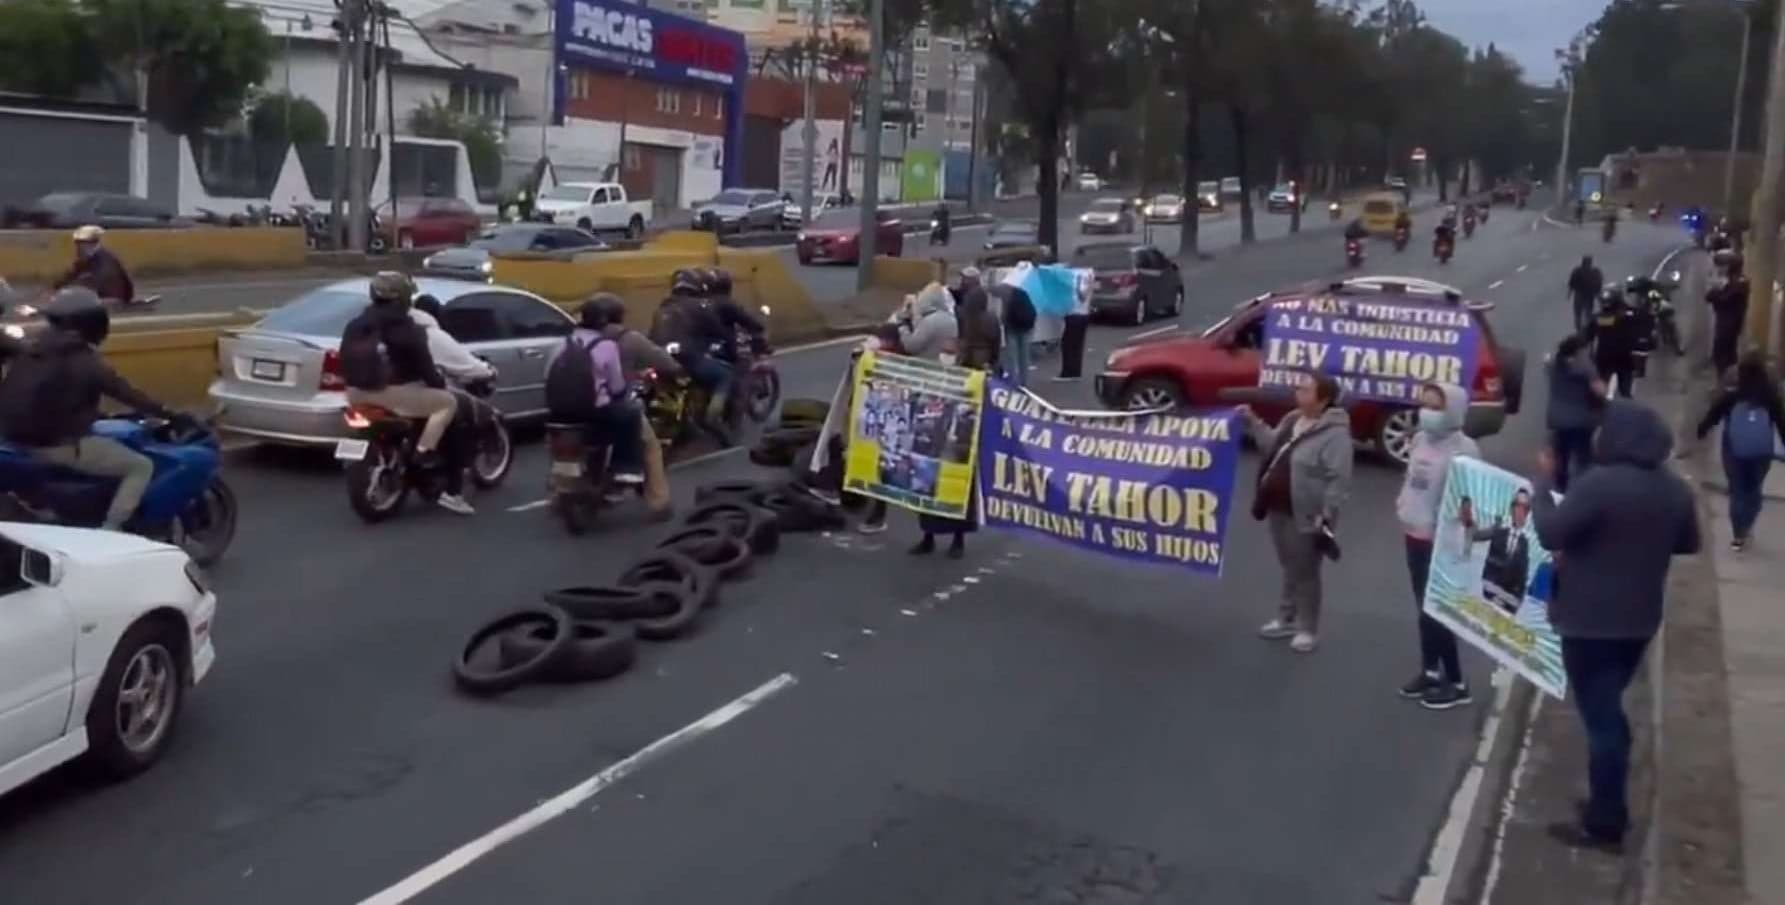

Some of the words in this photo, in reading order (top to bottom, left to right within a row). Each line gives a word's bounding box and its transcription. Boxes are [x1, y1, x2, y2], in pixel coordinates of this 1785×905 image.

[571, 1, 653, 53] PACAS
[1276, 313, 1291, 328] A
[1298, 315, 1324, 332] LA
[1331, 319, 1460, 345] COMUNIDAD
[1356, 303, 1471, 328] INJUSTICIA
[1266, 338, 1331, 370] LEV
[1341, 346, 1463, 385] TAHOR
[1360, 380, 1371, 395] A
[1001, 418, 1012, 439] A
[1019, 424, 1052, 449] LA
[1063, 435, 1213, 470] COMUNIDAD
[1144, 414, 1230, 441] APOYA
[993, 452, 1054, 503] LEV
[1066, 472, 1219, 534] TAHOR
[987, 496, 1085, 540] DEVUELVAN
[1091, 523, 1105, 544] A
[1112, 526, 1148, 554] SUS
[1155, 534, 1221, 565] HIJOS
